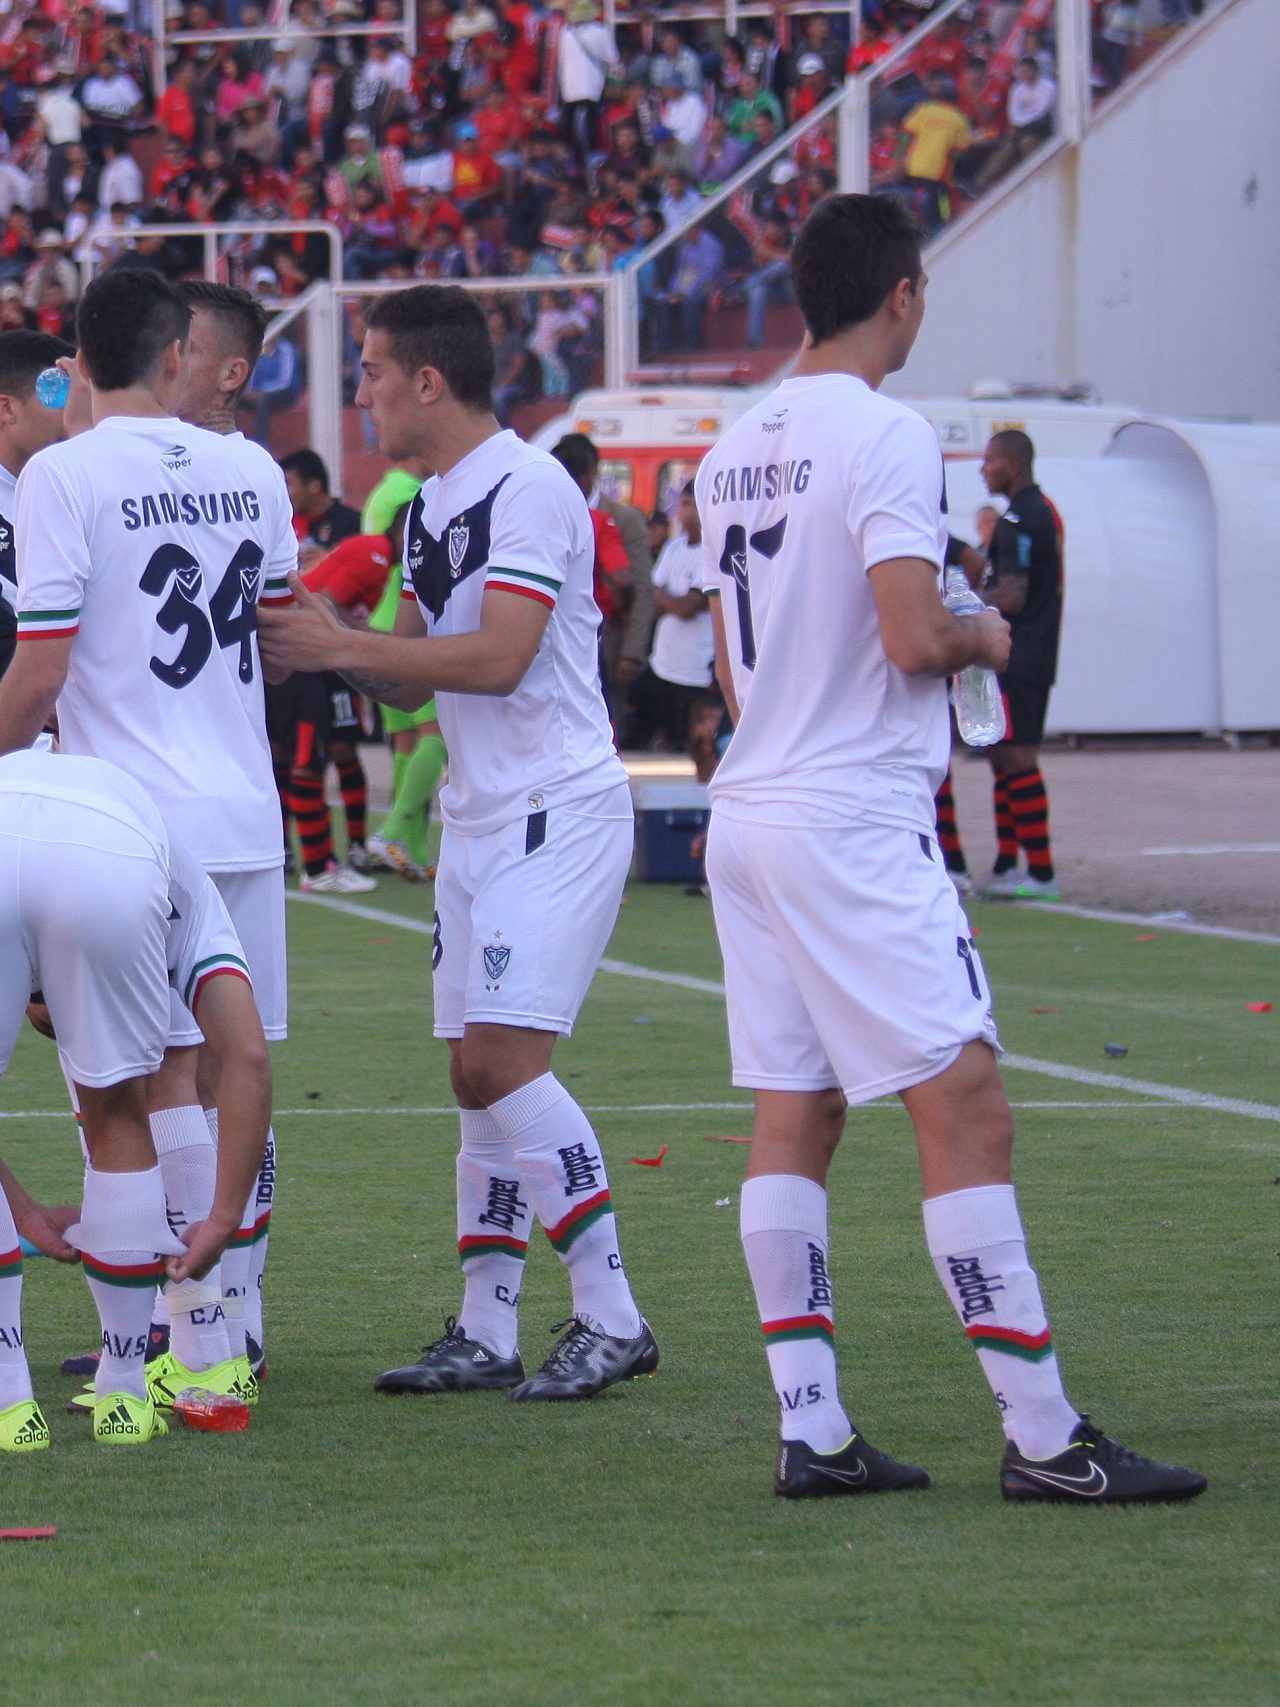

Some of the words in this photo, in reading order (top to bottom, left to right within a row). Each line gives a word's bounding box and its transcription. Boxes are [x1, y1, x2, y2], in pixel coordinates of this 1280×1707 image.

[761, 422, 786, 434] Topper
[160, 458, 192, 470] pper
[121, 490, 260, 531] SAMSUNG
[139, 539, 265, 690] 34
[558, 1142, 601, 1197] Topper
[478, 1176, 528, 1233] Topper
[807, 1242, 832, 1312] Topper
[946, 1256, 1005, 1324] Topper
[13, 1430, 49, 1446] adida
[97, 1421, 140, 1436] adidas
